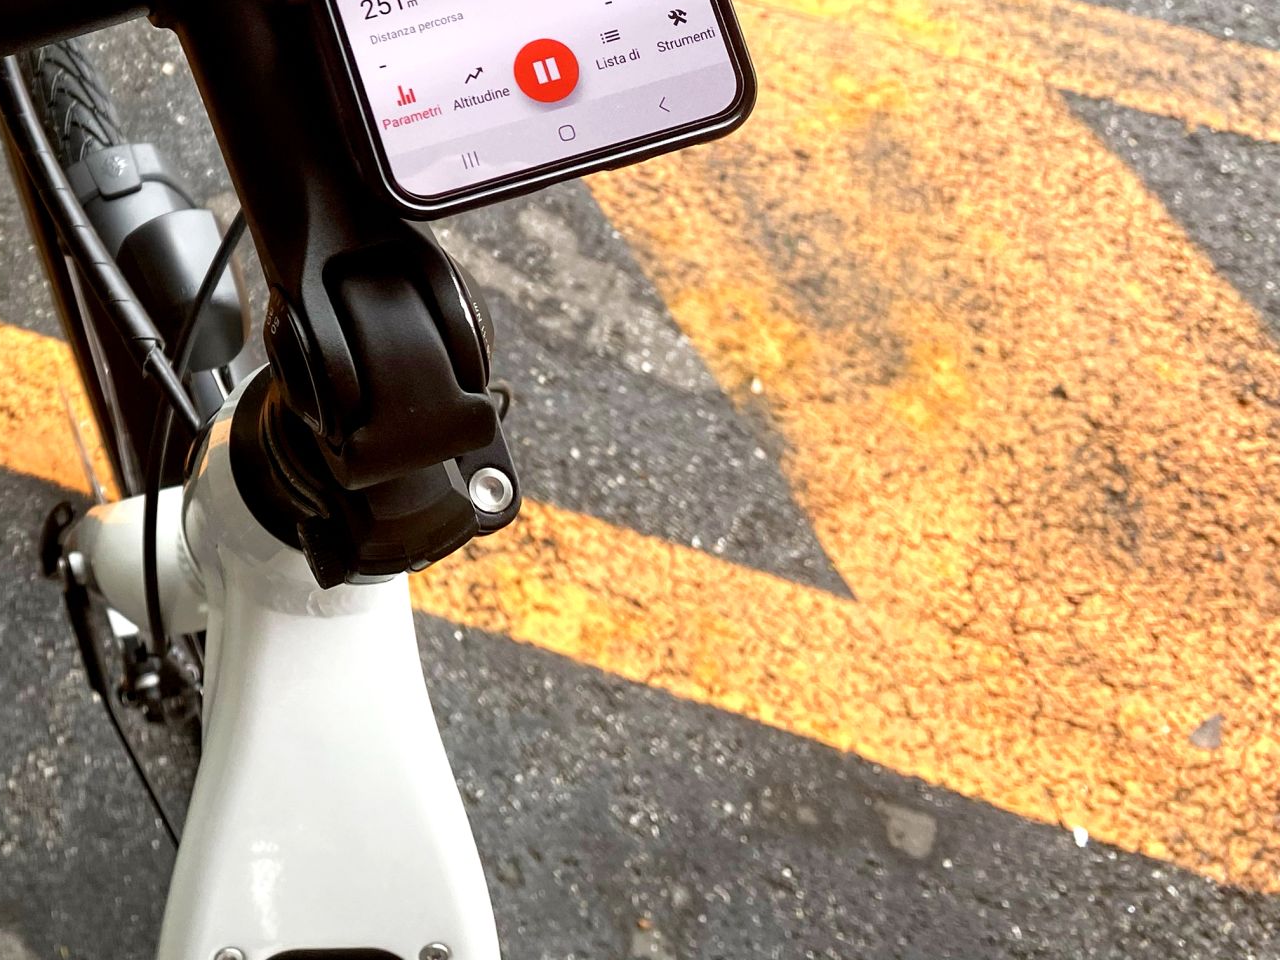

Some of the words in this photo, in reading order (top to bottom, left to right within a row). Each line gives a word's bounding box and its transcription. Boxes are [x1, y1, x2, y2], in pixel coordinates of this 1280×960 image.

[370, 26, 416, 45] Distanza
[418, 12, 464, 33] percorsa
[657, 27, 716, 53] Strumenti
[596, 54, 627, 70] Lista
[629, 48, 641, 61] di
[453, 86, 510, 111] Altitudine
[382, 105, 442, 130] Parametri
